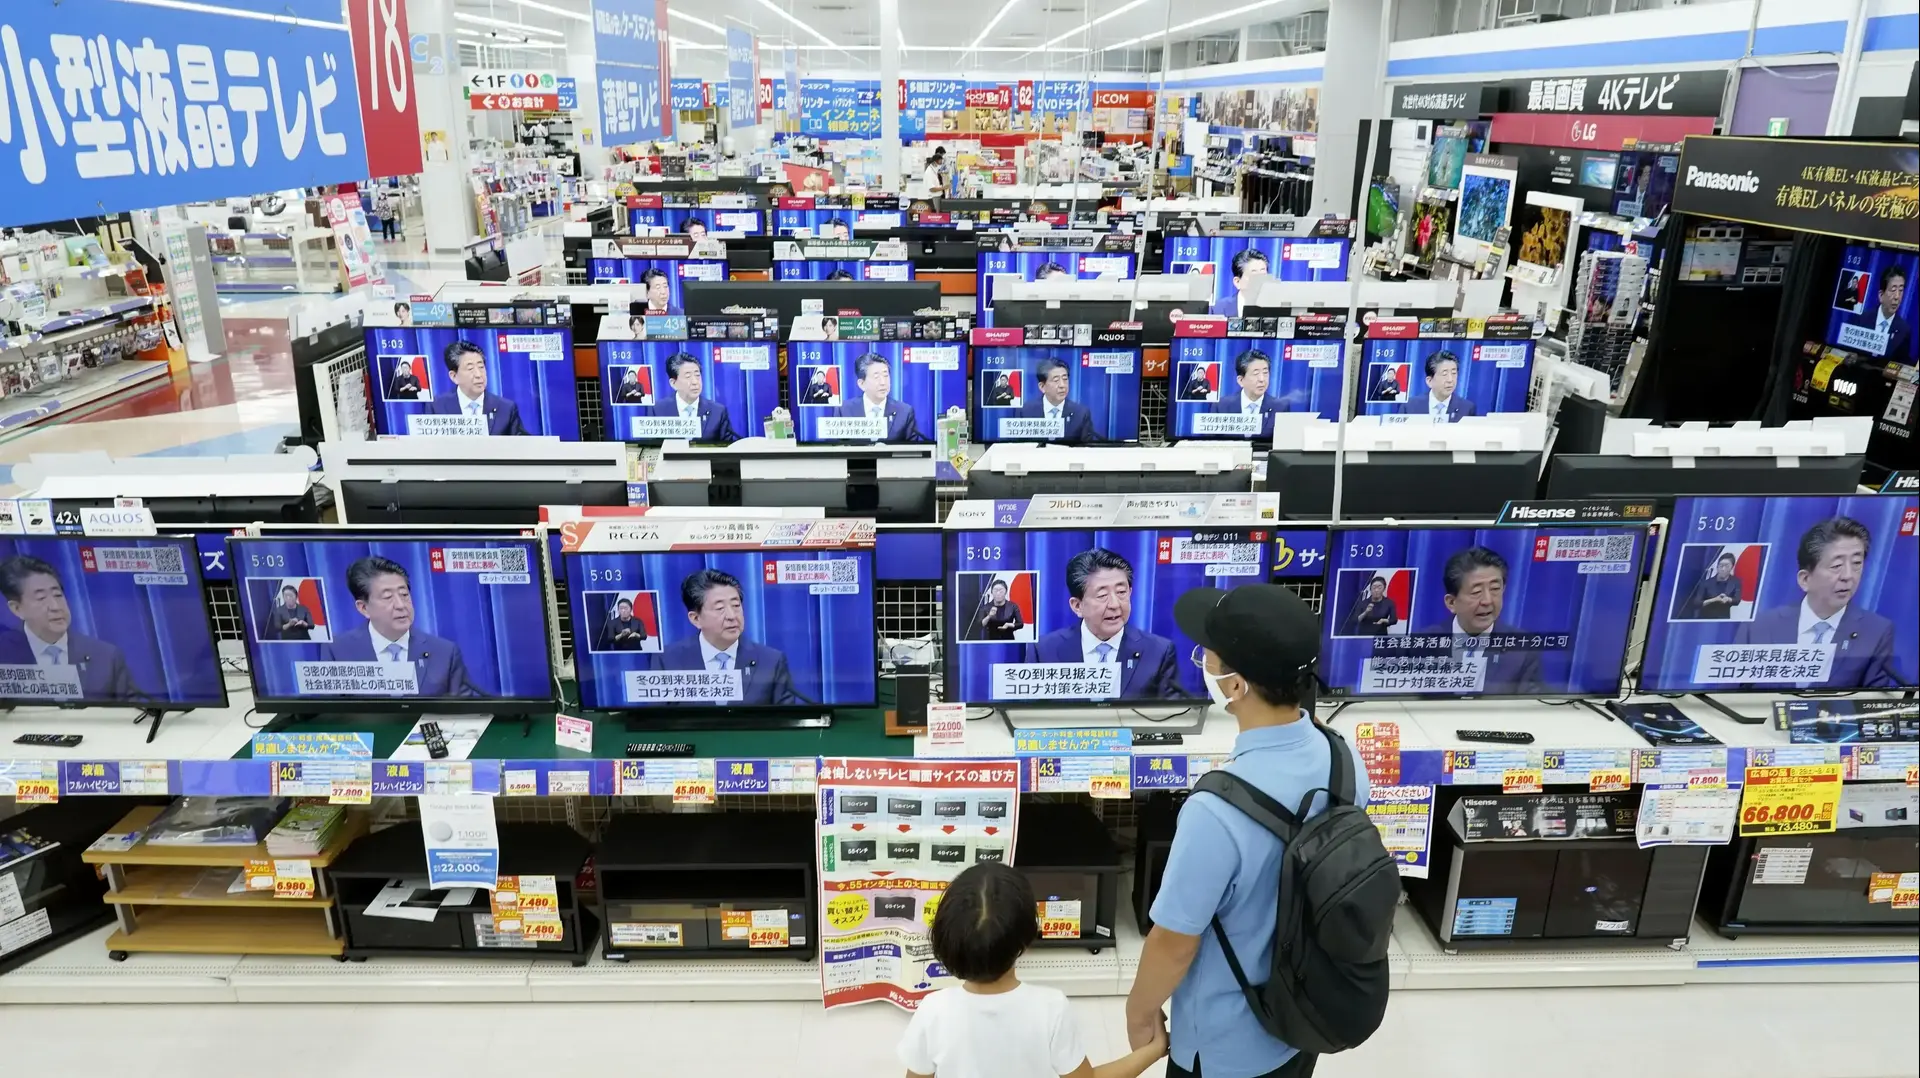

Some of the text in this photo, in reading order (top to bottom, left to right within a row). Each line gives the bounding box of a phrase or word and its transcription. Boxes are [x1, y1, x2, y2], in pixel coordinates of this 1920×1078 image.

[487, 75, 506, 88] 1F
[760, 84, 772, 103] 60
[1019, 86, 1032, 105] 62
[1527, 73, 1681, 112] 最高画質 4Kテレビ
[0, 24, 347, 184] 小型液晶テレビ
[511, 96, 545, 108] お会計
[910, 98, 962, 109] 小型プリンター
[1095, 93, 1129, 105] J:COM
[1401, 92, 1467, 110] 次世代4K対応液晶テレビ
[602, 78, 660, 134] 薄型テレビ
[1582, 124, 1597, 142] LG
[1685, 165, 1760, 194] Panasonic
[639, 215, 655, 223] 5:03
[782, 216, 798, 224] 5:03
[1178, 246, 1198, 256] 5:03
[989, 260, 1006, 269] 5:03
[1847, 255, 1861, 265] 5:03
[597, 265, 614, 275] 5:03
[784, 268, 800, 276] 5:03
[430, 305, 445, 317] 49
[664, 318, 679, 330] 43
[857, 319, 872, 330] 43
[381, 339, 404, 349] 5:03
[612, 351, 632, 360] 5:03
[801, 351, 821, 360] 5:03
[1184, 347, 1203, 357] 5:03
[1376, 348, 1395, 358] 5:03
[987, 356, 1005, 365] 5:03
[415, 418, 482, 426] 冬の到来見据えた
[1199, 424, 1257, 432] コロナ対策を決定
[416, 427, 483, 436] コロナ対策を決定
[1006, 428, 1060, 436] コロナ対策を決定
[1879, 422, 1910, 438] TOKYO 2020
[1049, 500, 1082, 509] フルHD
[1126, 499, 1178, 508] 声が聞きやすい
[90, 513, 143, 524] AQUOS
[1511, 506, 1576, 519] Hisense
[999, 514, 1012, 524] 43
[1698, 516, 1736, 531] 5:03
[1901, 511, 1916, 533] 中継
[563, 523, 579, 546] S
[609, 532, 659, 540] REGZA
[689, 532, 753, 540] 安心のウラ録対応
[1203, 533, 1238, 541] 地デジ 011
[1557, 538, 1605, 548] 安倍首相 記者会見
[476, 551, 499, 560] 記者会見
[966, 546, 1001, 560] 5:03
[1159, 540, 1169, 560] 中継
[1194, 551, 1228, 560] 正式に表明へ
[1350, 544, 1384, 558] 5:03
[252, 554, 285, 567] 5:03
[808, 563, 831, 572] 記者会見
[1209, 566, 1256, 574] ネットでも配信
[1581, 564, 1627, 573] ネットでも配信
[137, 575, 184, 583] ネットでも配信
[590, 569, 623, 581] 5:03
[813, 585, 856, 593] ネットでも配信
[1373, 635, 1569, 649] 社会経済活動との両立は十分に可
[1372, 655, 1454, 667] 能であります。
[1711, 648, 1826, 663] 冬の到来見据えた
[303, 665, 384, 677] 3密の徹底的回避で
[1005, 667, 1113, 680] 冬の到来見据えた
[1375, 662, 1478, 675] 冬の到来見据えた
[1708, 664, 1821, 679] コロナ対策を決定
[304, 678, 415, 691] 社会経済活動との両立可能
[636, 673, 734, 685] 冬の到来見据えた
[1372, 676, 1475, 689] コロナ対策を決定
[637, 686, 735, 698] コロナ対策を決定
[1004, 681, 1112, 695] コロナ対策を決定
[1360, 728, 1371, 737] 2K
[1150, 758, 1173, 770] 液晶
[1455, 755, 1470, 768] 43
[1544, 755, 1558, 768] 50
[1641, 755, 1655, 768] 55
[1754, 753, 1769, 766] 43
[1860, 752, 1874, 764] 50
[81, 763, 105, 777] 液晶
[280, 767, 296, 781] 40
[386, 765, 410, 777] 液晶
[623, 766, 638, 779] 40
[731, 763, 754, 775] 液晶
[820, 766, 1016, 783] 後悔しないテレビ画面サイズの選び方
[1039, 763, 1055, 776] 43
[1750, 769, 1788, 778] 広告の品
[69, 780, 119, 790] フルハイビジョン
[718, 780, 767, 789] フルハイビジョン
[1137, 775, 1185, 784] フルハイビジョン
[373, 781, 423, 791] フルハイビジョン
[1366, 805, 1429, 815] 長期無料保証
[441, 864, 481, 873] 22,000
[827, 904, 869, 915] 買い替えに
[833, 915, 864, 925] オススメ
